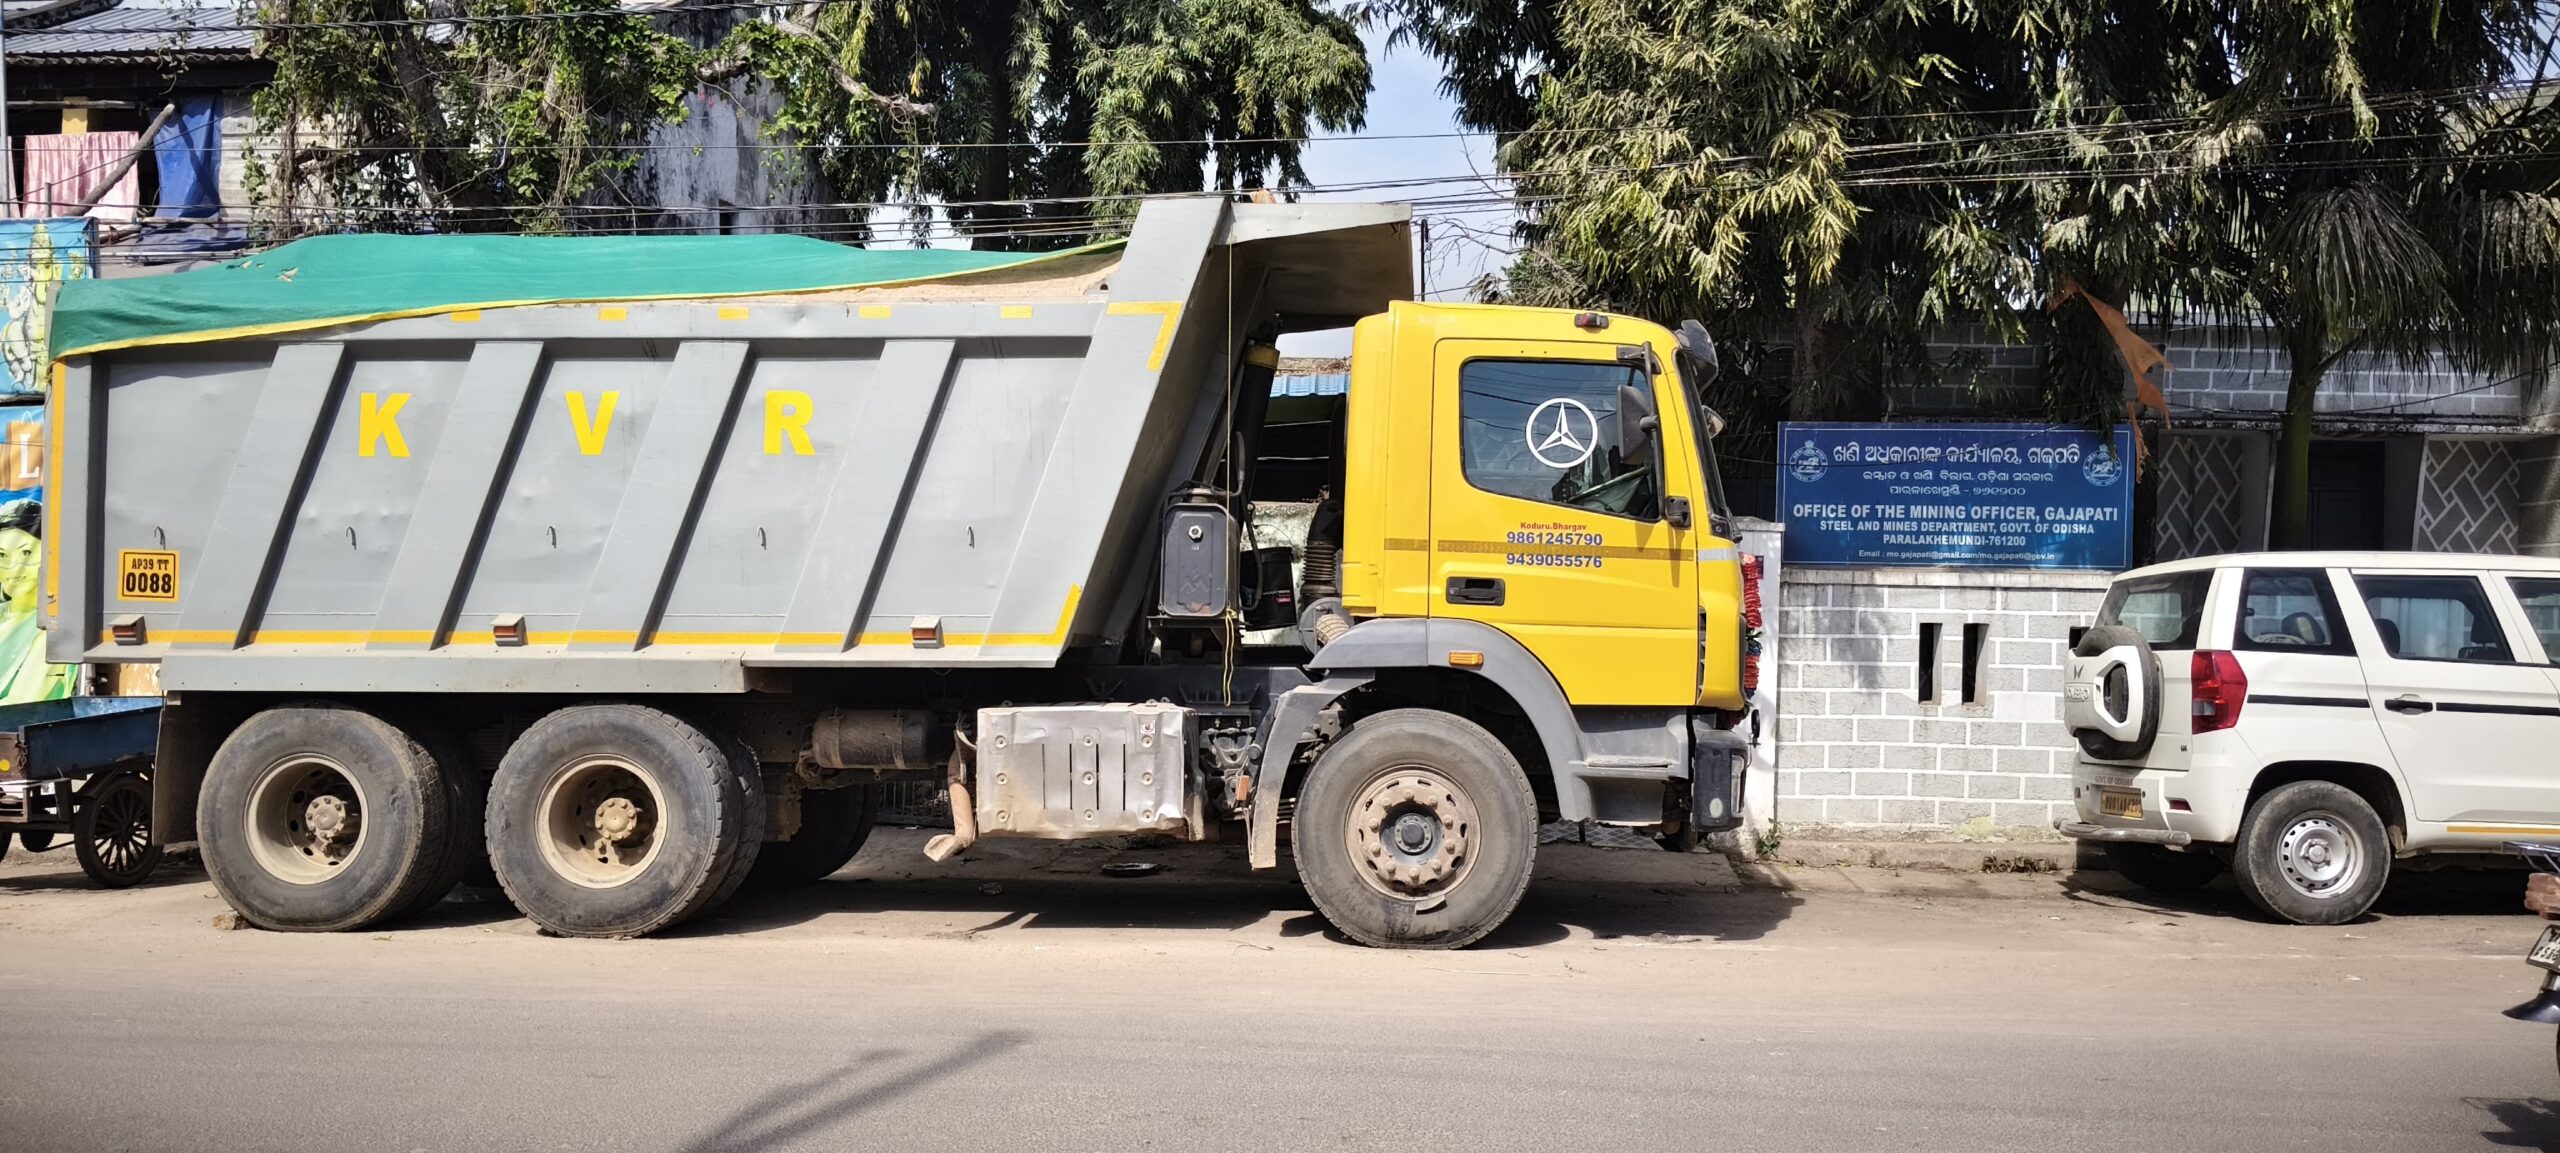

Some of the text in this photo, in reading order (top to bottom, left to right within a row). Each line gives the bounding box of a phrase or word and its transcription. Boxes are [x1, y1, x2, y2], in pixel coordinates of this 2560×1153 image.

[358, 389, 816, 457] K V R
[19, 433, 40, 478] L
[1833, 441, 1860, 462] ଖଣି
[2027, 443, 2080, 464] ଗଜପତି
[1899, 471, 1910, 480] ଓ
[1793, 504, 2118, 523] OFFICE OF THE MINING OFFICER, GAJAPATI
[1520, 522, 1587, 532] Koduru.Bhargav
[1820, 520, 2095, 535] STEEL AND MINES DEPARTMENT, GOVT. OF ODISHA
[1507, 531, 1603, 546] 9861245790
[1883, 534, 2026, 546] PARALAKHEMUNDI-761200
[1506, 553, 1602, 568] 9439055576
[1858, 550, 1881, 558] Email
[132, 558, 170, 571] AP39 TT
[126, 572, 172, 594] 0088
